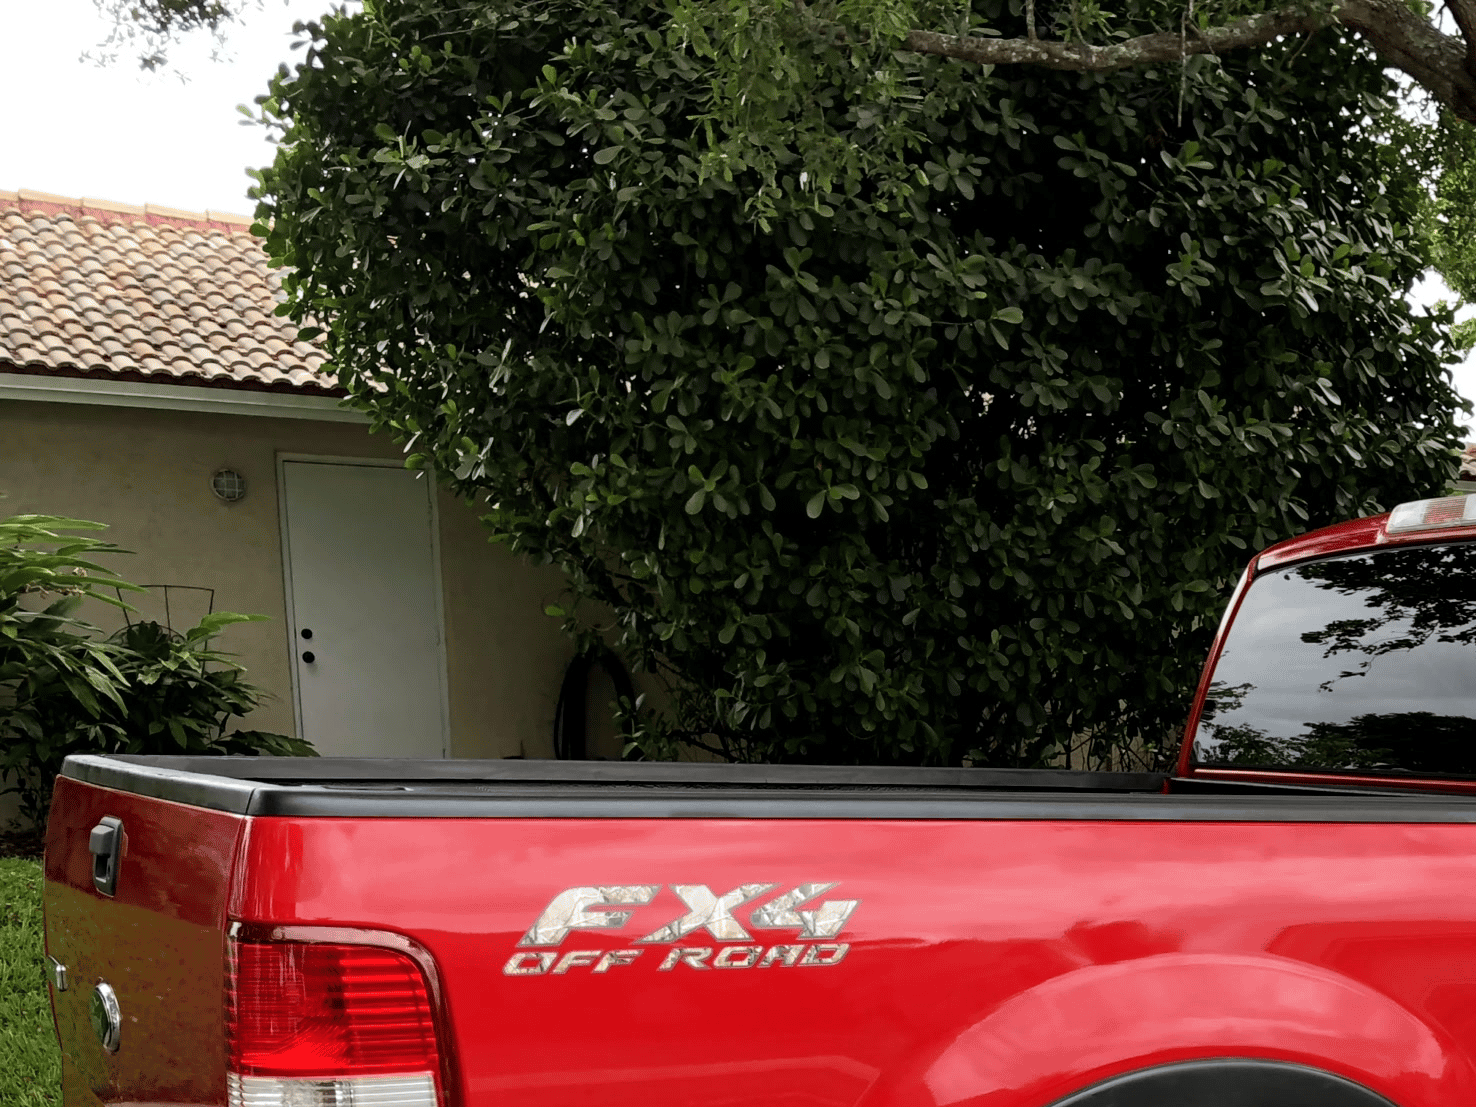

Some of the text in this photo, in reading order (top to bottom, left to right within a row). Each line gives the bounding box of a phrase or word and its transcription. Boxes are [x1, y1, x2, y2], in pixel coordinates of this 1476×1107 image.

[515, 882, 862, 948] FX4
[502, 943, 851, 976] OFF ROAD
